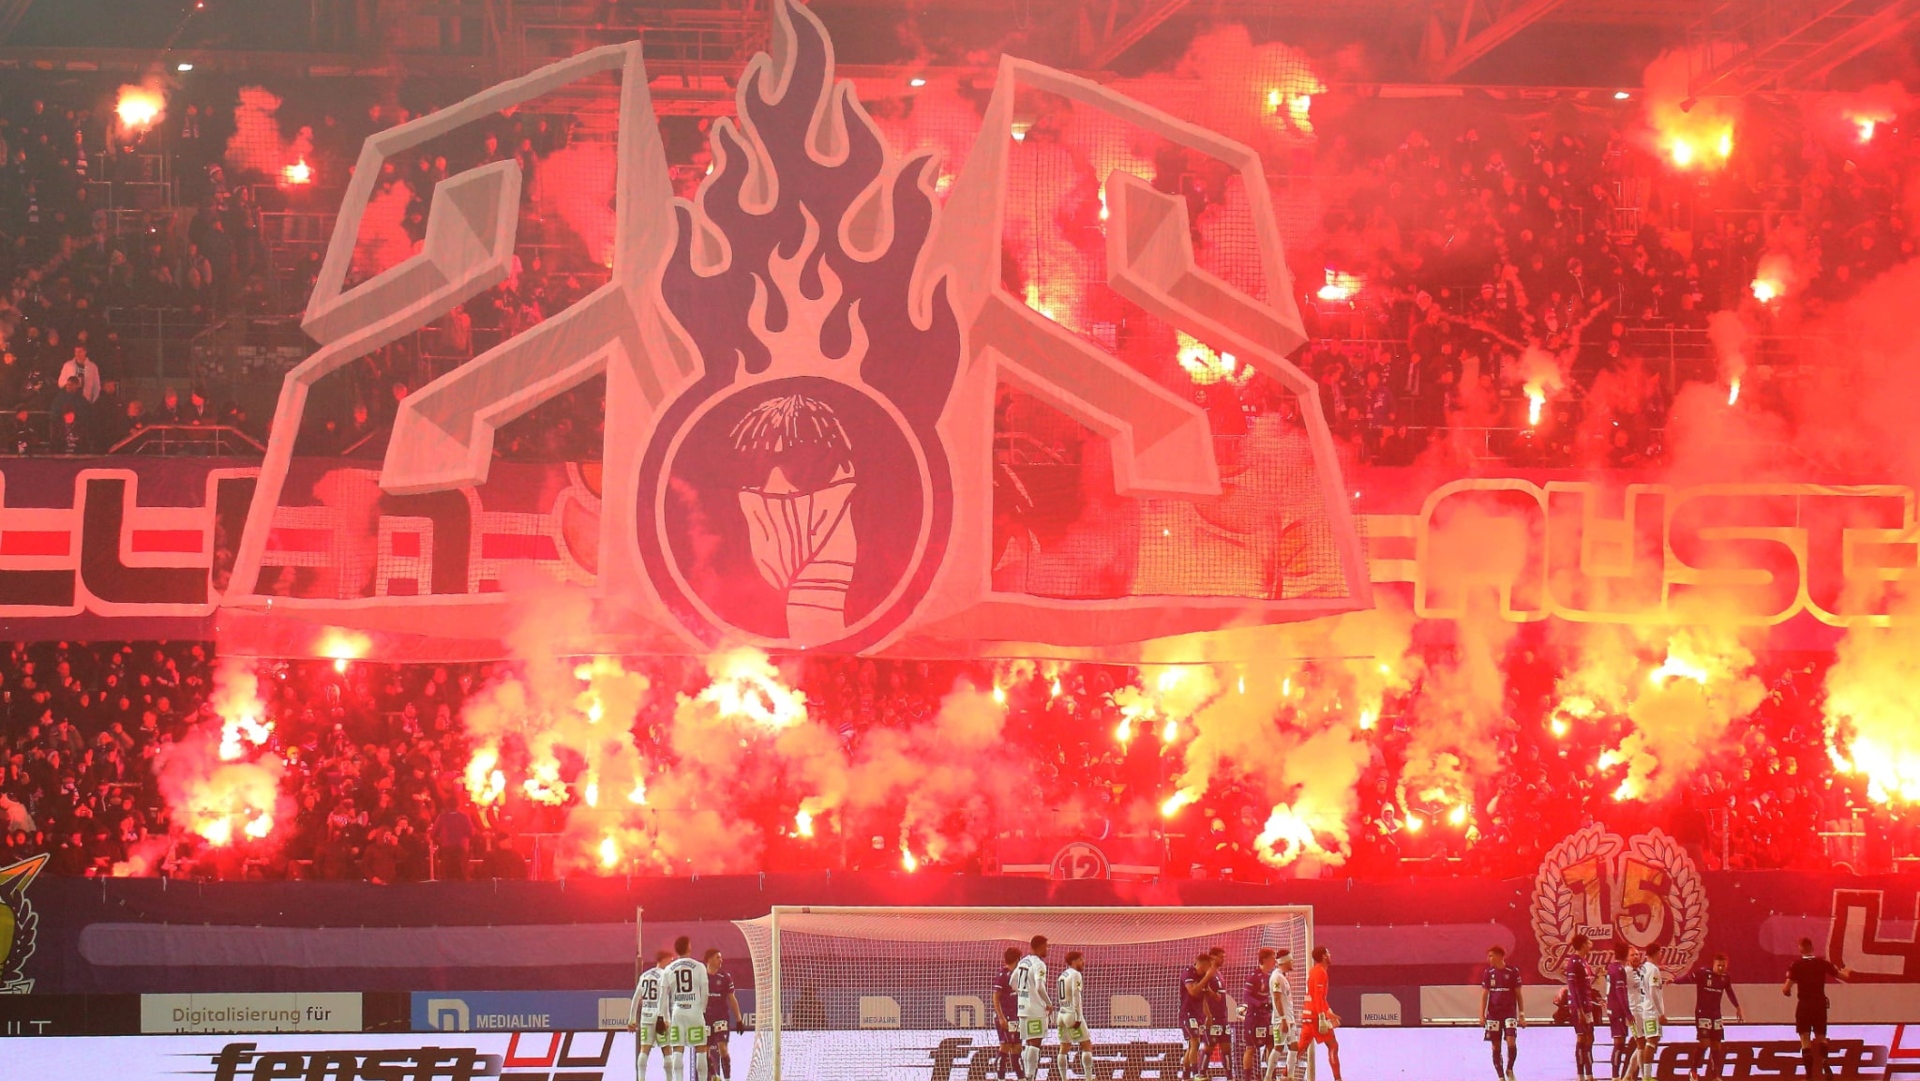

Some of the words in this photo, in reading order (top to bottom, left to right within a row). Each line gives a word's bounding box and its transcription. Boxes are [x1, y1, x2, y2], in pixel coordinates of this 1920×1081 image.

[1414, 478, 1920, 627] AUST
[641, 979, 658, 1000] 26
[674, 969, 693, 994] 19
[172, 1007, 301, 1025] Digitalisierung
[306, 1006, 332, 1021] für
[476, 1014, 550, 1028] MEDIALINE
[1364, 1013, 1399, 1021] MEDIALINE
